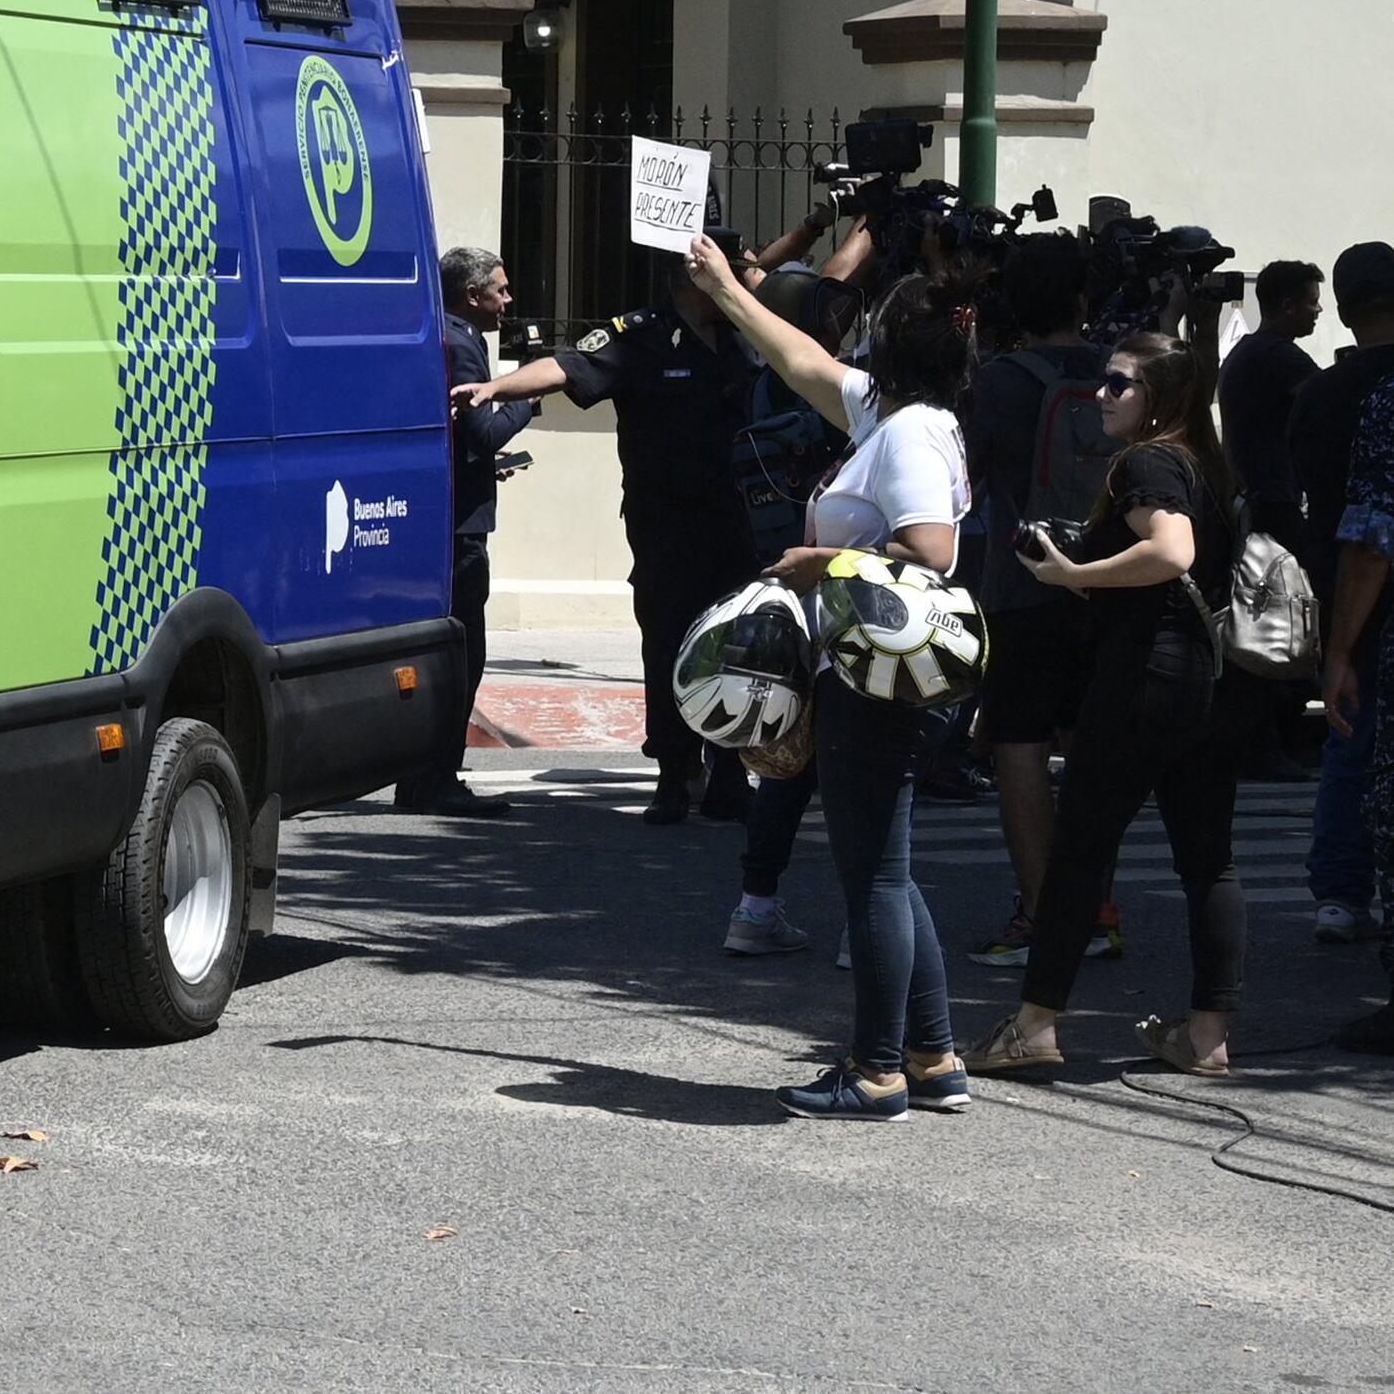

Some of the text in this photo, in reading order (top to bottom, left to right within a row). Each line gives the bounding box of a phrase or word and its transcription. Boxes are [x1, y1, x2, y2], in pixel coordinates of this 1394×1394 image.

[637, 155, 687, 188] MORÓN
[635, 192, 701, 229] PRESENTE
[354, 495, 407, 520] Buenos Aires
[354, 523, 389, 547] Provincia
